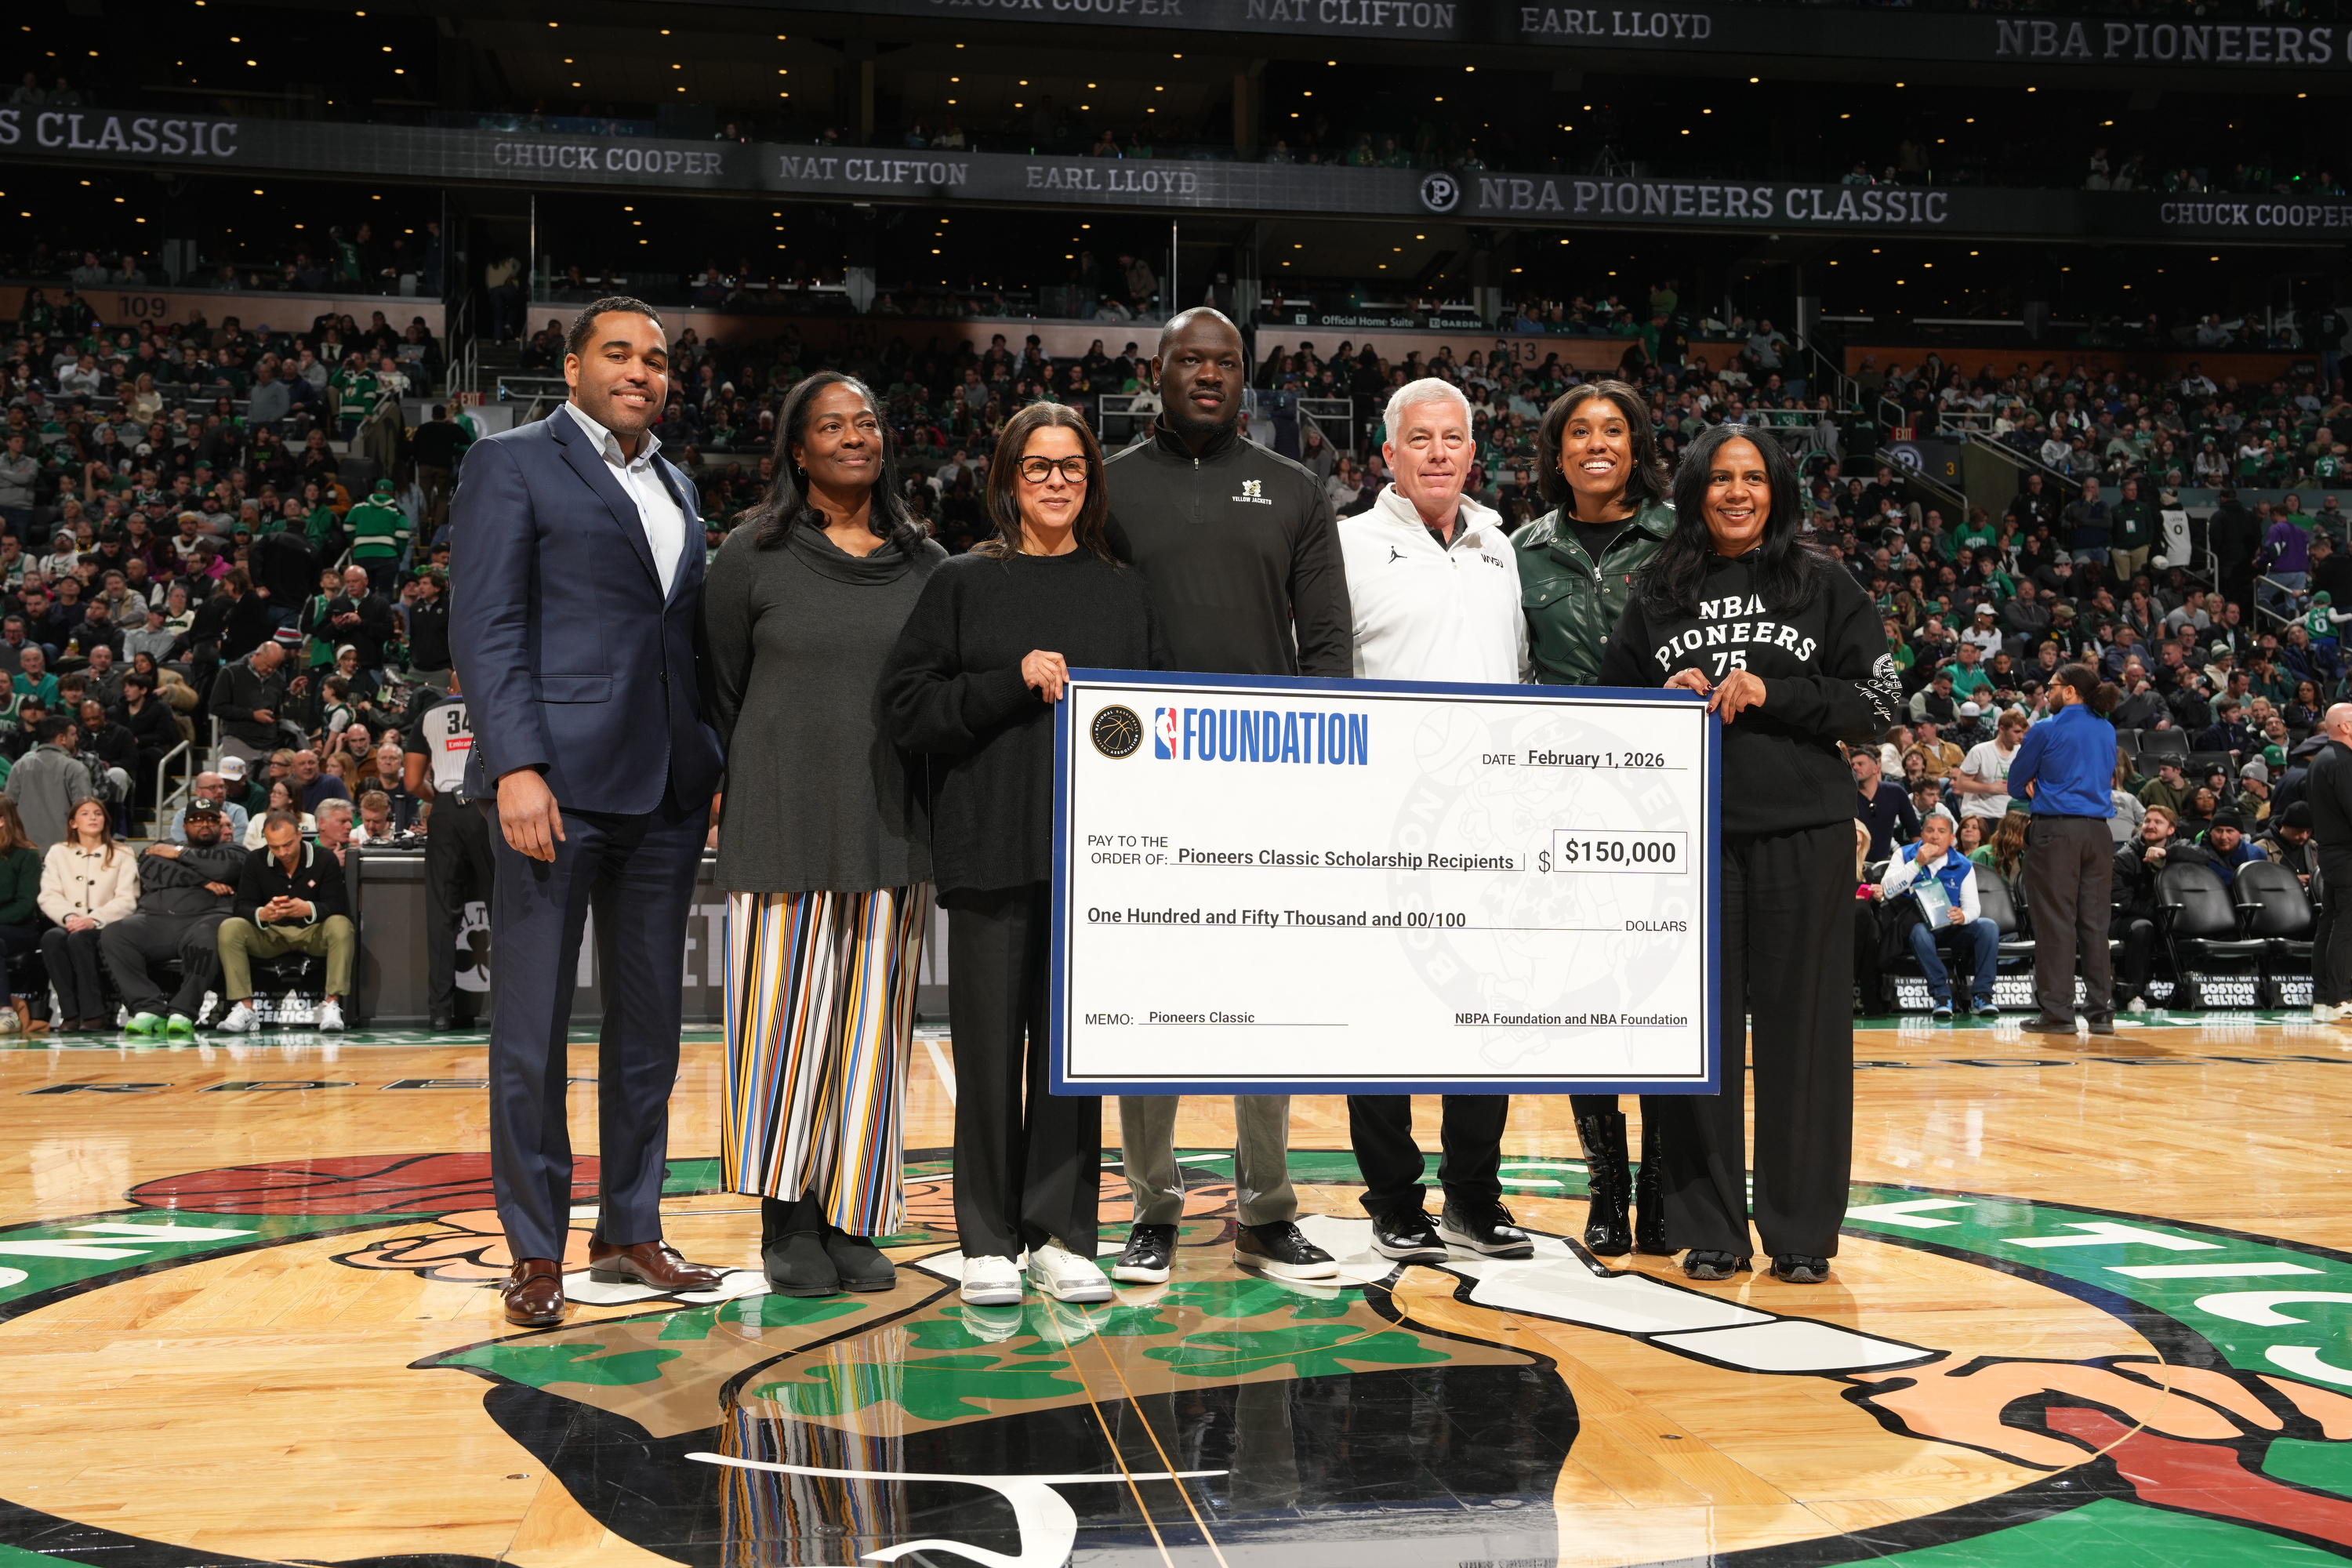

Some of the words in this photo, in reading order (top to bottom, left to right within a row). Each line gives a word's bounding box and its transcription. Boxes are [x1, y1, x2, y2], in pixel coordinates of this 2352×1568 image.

[1246, 0, 1306, 22] NAT
[1319, 0, 1457, 29] CLIFTON
[1520, 7, 1605, 35] EARL
[1612, 11, 1712, 39] LLOYD
[1995, 19, 2093, 59] NBA
[2103, 22, 2333, 64] PIONEERS
[36, 111, 238, 158] CLASSIC
[494, 143, 600, 172] CHUCK
[604, 147, 724, 176] COOPER
[779, 155, 840, 181] NAT
[844, 158, 969, 187] CLIFTON
[1025, 165, 1102, 191] EARL
[1107, 169, 1199, 194] LLOYD
[1478, 177, 1565, 212] NBA
[1572, 180, 1775, 220] PIONEERS
[1784, 187, 1949, 223] CLASSIC
[2160, 202, 2250, 226] CHUCK
[120, 296, 166, 318] 109
[1321, 314, 1358, 326] Official
[1359, 316, 1388, 327] Home
[1389, 317, 1414, 328] Suite
[1440, 320, 1482, 328] GARDEN
[460, 393, 481, 406] EXIT
[1896, 427, 1913, 441] EXIT
[1946, 462, 1955, 476] 3
[1252, 497, 1272, 506] JACKETS
[2174, 524, 2183, 535] 0
[1480, 553, 1504, 568] WVSU
[1698, 593, 1766, 620] NBA
[2314, 618, 2328, 633] 0
[1654, 622, 1817, 673] PIONEERS
[1711, 650, 1748, 677] 75
[1094, 710, 1113, 732] NATIONAL
[1116, 709, 1139, 732] BASKETBALL
[1094, 732, 1110, 753] PLAYERS
[1109, 734, 1139, 755] ASSOCIATION
[1182, 707, 1368, 766] FOUNDATION
[1482, 753, 1516, 766] DATE
[1528, 750, 1600, 769] February
[1605, 752, 1619, 769] 1,
[1624, 752, 1665, 768] 2026
[1087, 834, 1113, 847] PAY
[1117, 835, 1137, 848] TO
[1141, 836, 1169, 848] THE
[1091, 852, 1142, 866] ORDER
[1145, 853, 1168, 866] OF:
[1178, 848, 1254, 865] Pioneers
[1258, 849, 1320, 866] Classic
[1324, 851, 1423, 871] Scholarship
[1427, 853, 1514, 872] Recipients
[1538, 849, 1551, 875] $
[1565, 837, 1676, 866] $150,000
[1886, 880, 1908, 896] CLUB
[1087, 907, 1122, 923] One
[1127, 908, 1200, 924] Hundred
[1205, 909, 1236, 924] and
[1242, 909, 1279, 929] Fifty
[1283, 909, 1367, 926] Thousand
[1371, 911, 1402, 927] and
[1406, 912, 1466, 929] 00/100
[1625, 920, 1687, 932] DOLLARS
[1896, 985, 1929, 997] BOST
[1992, 982, 2033, 993] STON
[2200, 983, 2256, 995] BOSTON
[2281, 982, 2314, 994] BOST
[1899, 996, 1935, 1008] CELTI
[1991, 993, 2032, 1005] ELTICS
[2204, 994, 2255, 1006] CELTICS
[257, 1011, 314, 1023] CELTICS
[1084, 1013, 1134, 1025] MEMO:
[1149, 1011, 1206, 1024] Pioneers
[1209, 1011, 1255, 1024] Classic
[1455, 1013, 1490, 1024] NBPA
[1494, 1012, 1561, 1025] Foundation
[1564, 1013, 1587, 1025] and
[1591, 1013, 1617, 1025] NBA
[1621, 1013, 1688, 1025] Foundation
